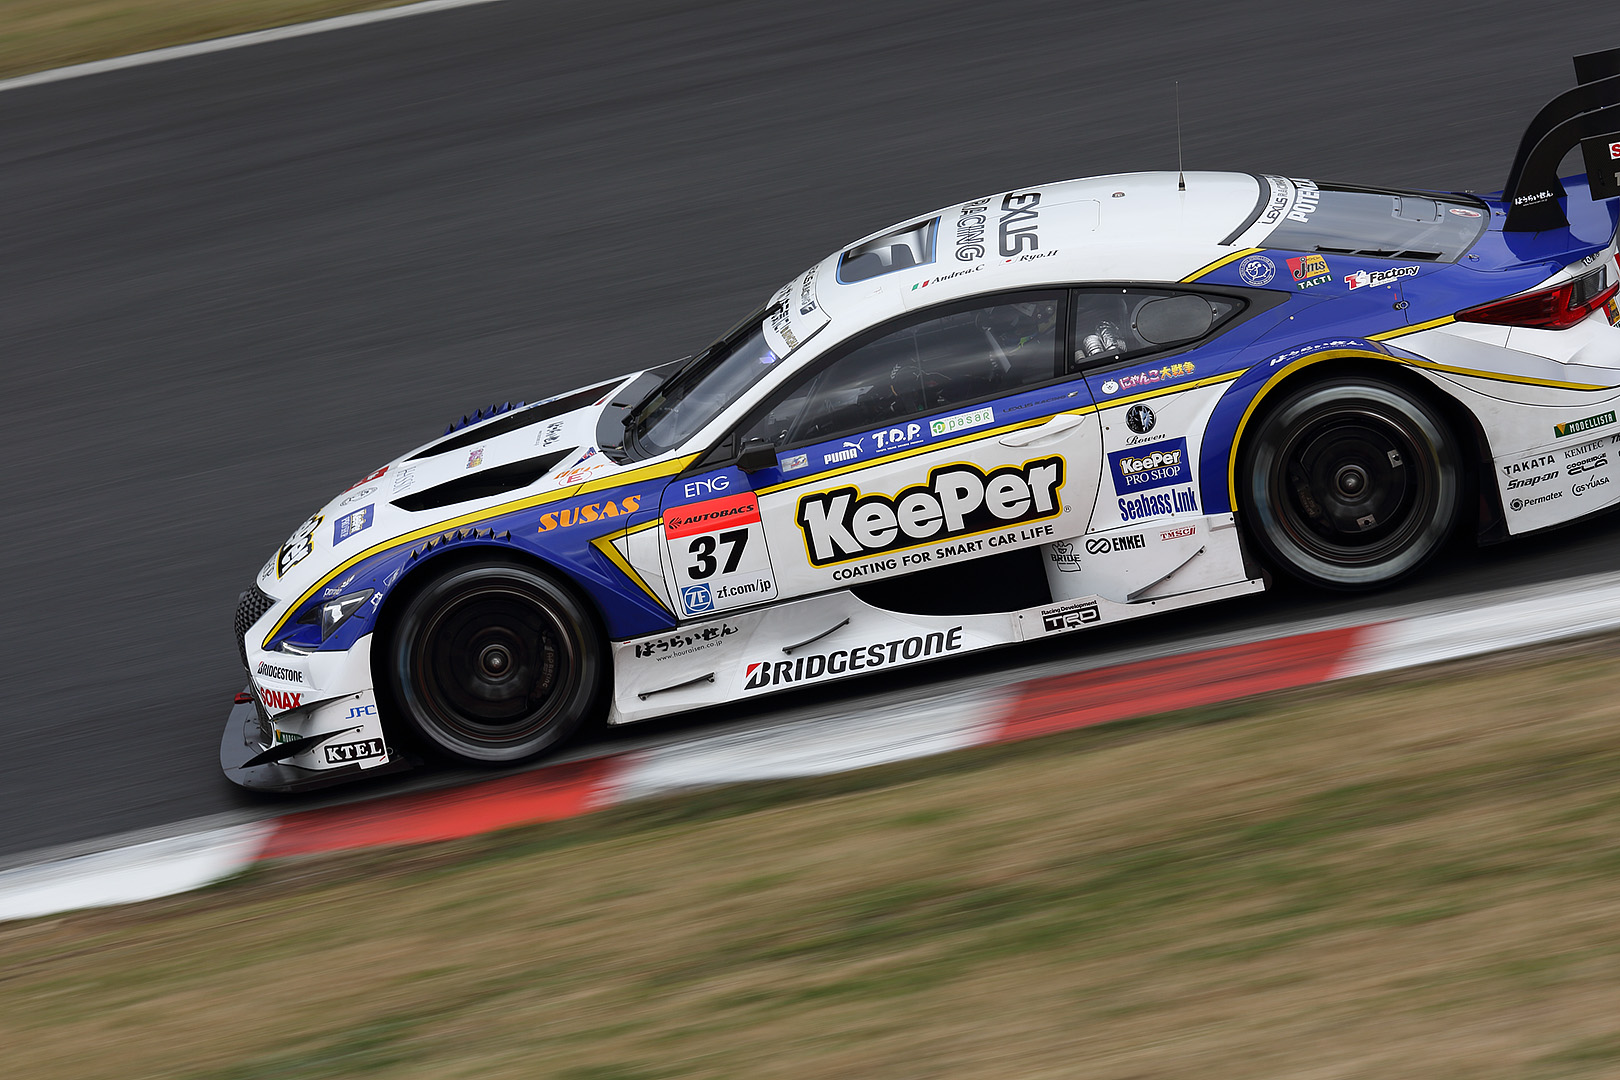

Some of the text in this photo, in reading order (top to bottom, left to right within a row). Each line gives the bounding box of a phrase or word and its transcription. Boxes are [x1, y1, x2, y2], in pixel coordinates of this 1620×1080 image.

[1298, 275, 1332, 289] TACTI
[1370, 266, 1418, 283] Factory
[1118, 361, 1196, 391] にゃんこ大戦争
[1569, 413, 1613, 433] MODELLISTA
[824, 448, 858, 465] PUMA
[1564, 440, 1604, 459] KEMITEC
[1120, 450, 1181, 476] KeePer
[1504, 455, 1556, 475] TAKATA
[1125, 466, 1181, 486] PRO SHOP
[1507, 470, 1559, 490] Snap-on
[684, 476, 730, 498] ENG
[1118, 491, 1173, 522] Seabass
[1524, 490, 1563, 506] Permatex
[538, 495, 641, 533] SUSAS
[684, 505, 754, 525] AUTOBACS
[803, 463, 1058, 560] KeePer
[1112, 534, 1146, 551] ENKEI
[687, 528, 749, 580] 37
[832, 525, 1054, 581] COATING FOR SMART CAR LIFE
[1051, 553, 1081, 563] BRIDE
[717, 579, 772, 599] zf.com/jp
[1060, 600, 1098, 611] Development
[1045, 609, 1098, 629] TRD
[656, 640, 723, 662] www.houraisen.co.jp
[744, 625, 963, 690] BRIDGESTONE
[257, 660, 303, 683] BRIDGESTONE
[260, 687, 302, 710] SONAX
[345, 704, 377, 719] JFC
[326, 741, 382, 762] KTEL
